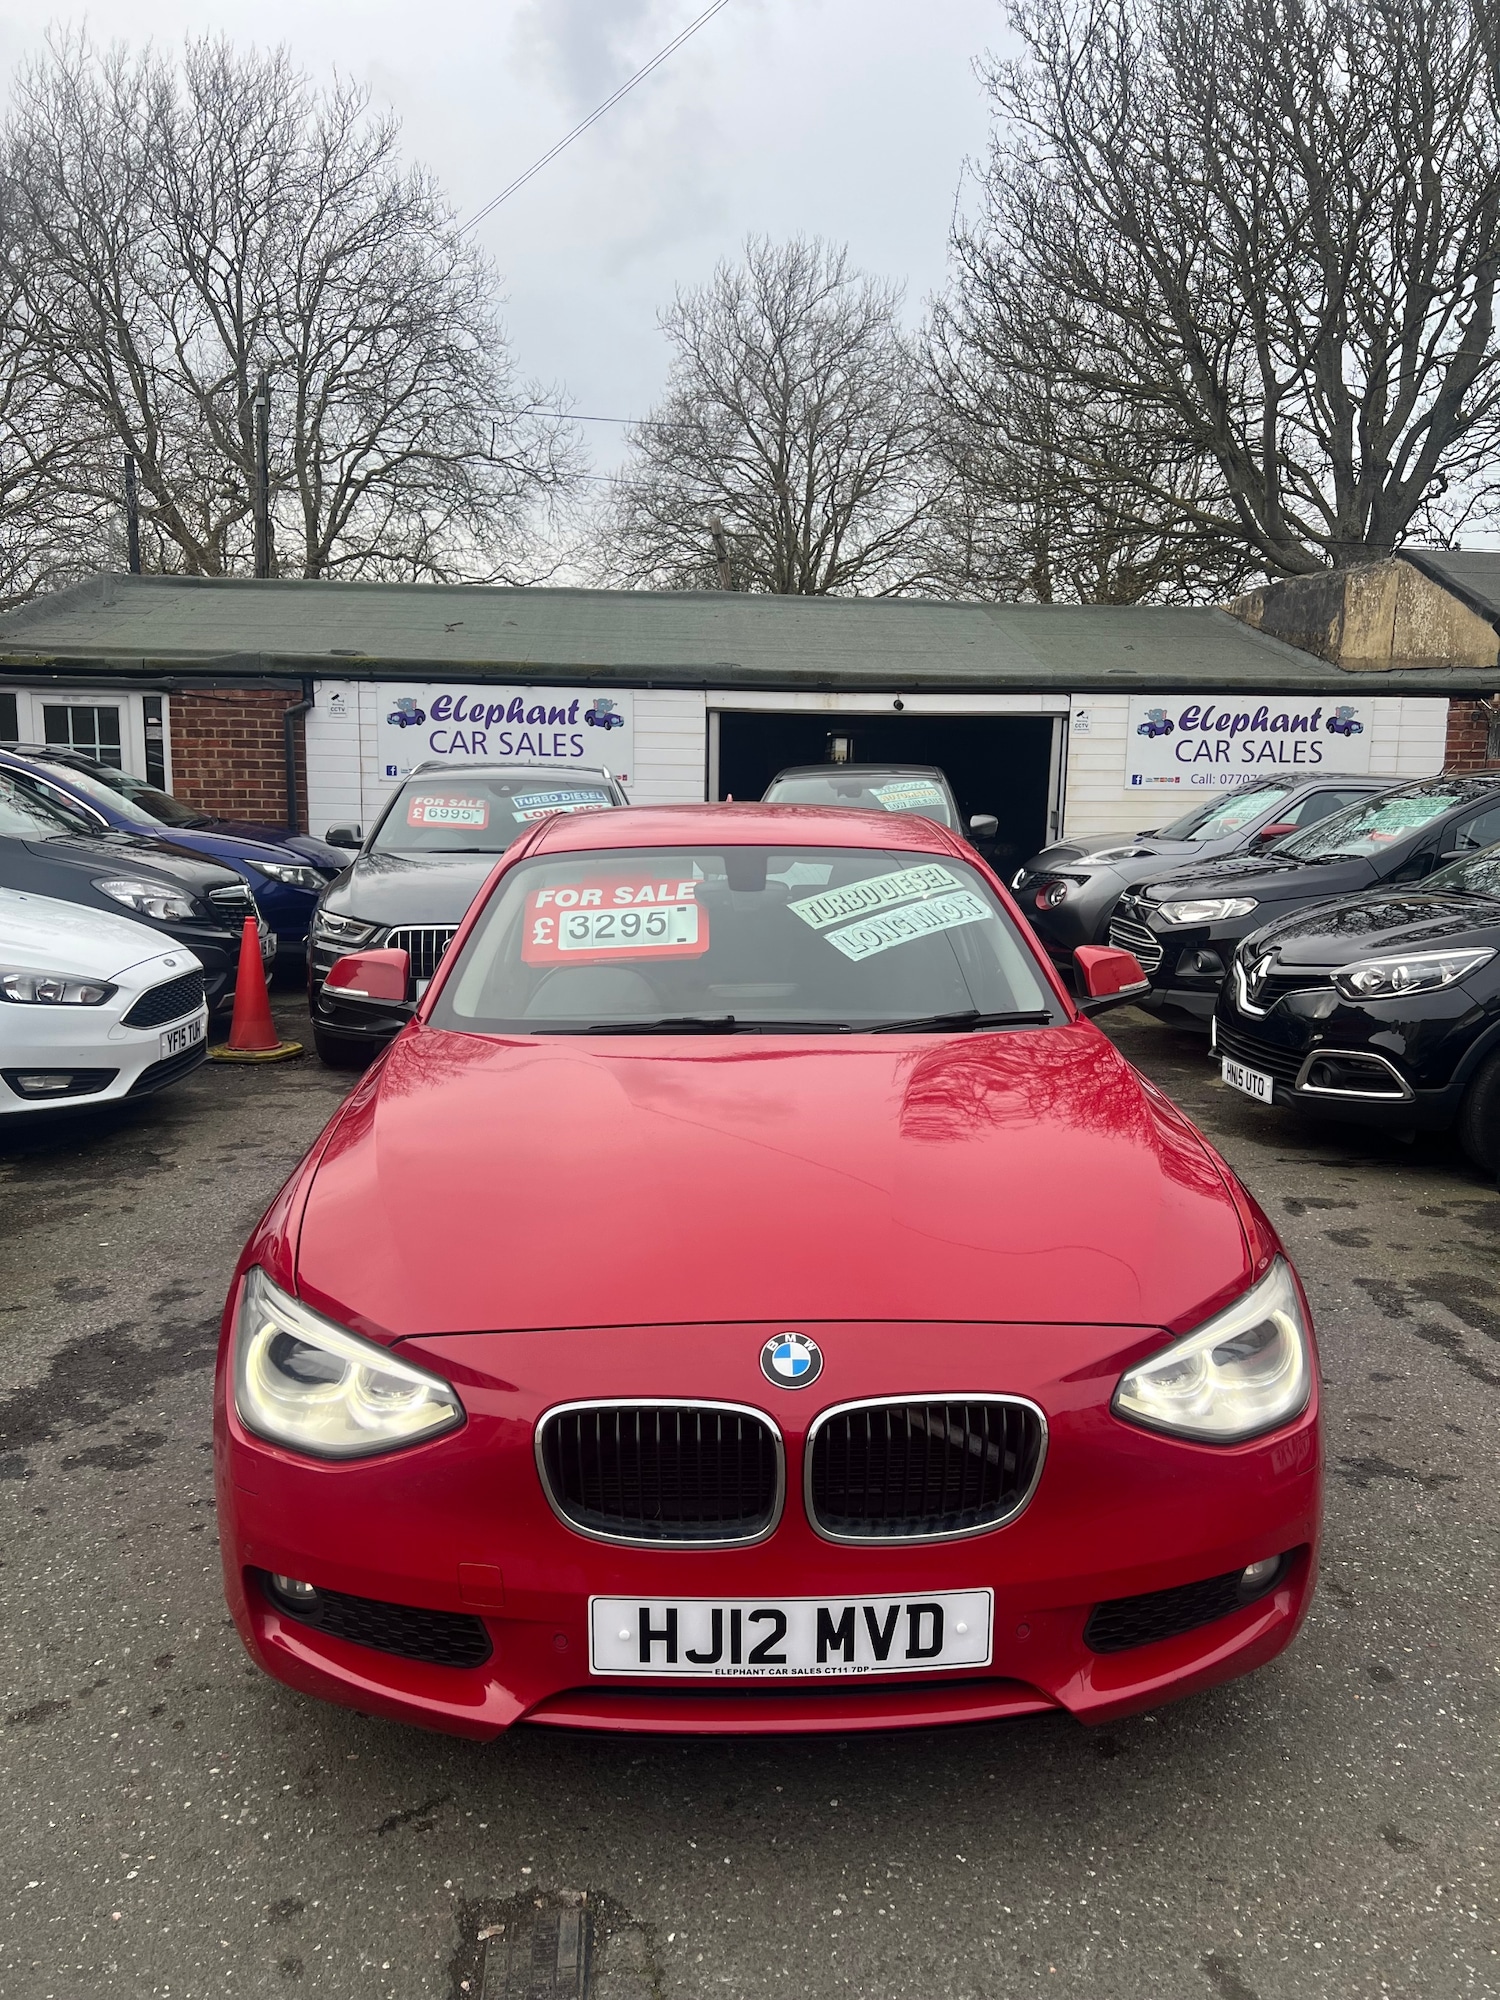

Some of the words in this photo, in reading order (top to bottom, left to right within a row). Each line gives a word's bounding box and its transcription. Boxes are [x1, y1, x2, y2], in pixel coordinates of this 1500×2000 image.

[430, 695, 580, 730] Elephant
[1178, 705, 1322, 738] Elephant
[429, 730, 488, 755] CAR
[499, 732, 585, 757] SALES
[1175, 739, 1231, 763] CAR
[1241, 740, 1323, 764] SALES
[1190, 773, 1216, 785] Call:
[414, 797, 449, 806] FOR
[449, 799, 486, 808] SALE
[516, 794, 558, 806] TURBO
[561, 791, 604, 801] DIESEL
[428, 808, 471, 820] 6995
[535, 888, 603, 909] FOR
[612, 881, 697, 905] SALE
[532, 917, 555, 945] £
[568, 911, 667, 940] 3295
[834, 914, 919, 954] LONG
[167, 1028, 186, 1053] YF15
[1246, 1071, 1265, 1096] UTO
[766, 1334, 817, 1351] BMW
[638, 1607, 788, 1665] HJ12
[816, 1602, 945, 1663] MVD
[715, 1668, 766, 1676] ELEPHANT
[791, 1667, 822, 1675] SALES
